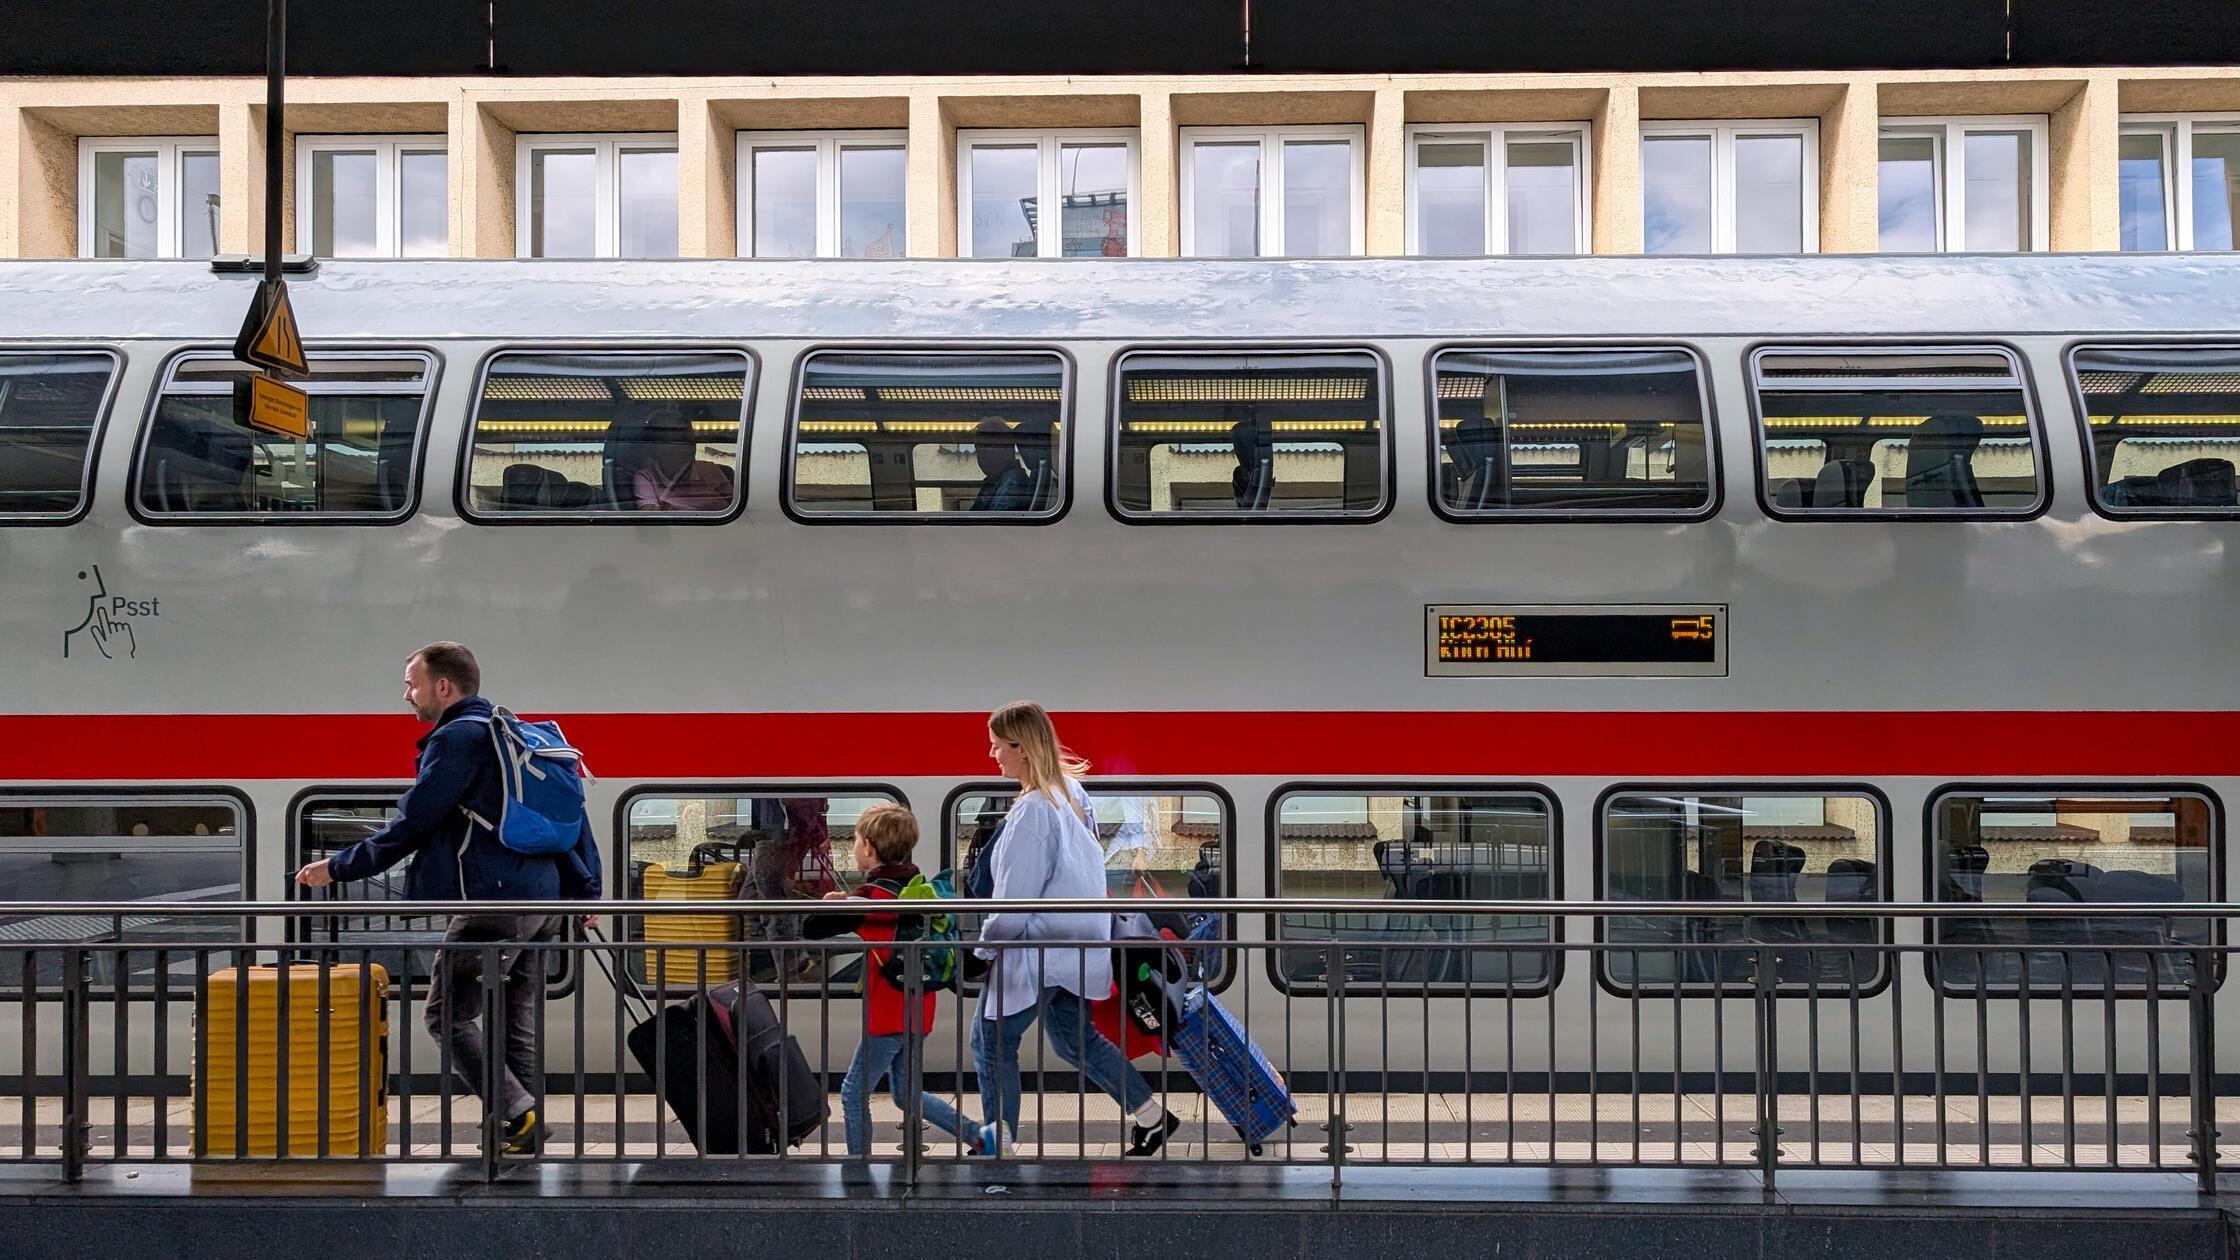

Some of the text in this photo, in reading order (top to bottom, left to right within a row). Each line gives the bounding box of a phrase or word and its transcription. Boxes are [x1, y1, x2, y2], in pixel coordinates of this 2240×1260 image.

[112, 596, 160, 617] Psst
[1440, 616, 1516, 639] IC2305
[1700, 616, 1713, 639] 5
